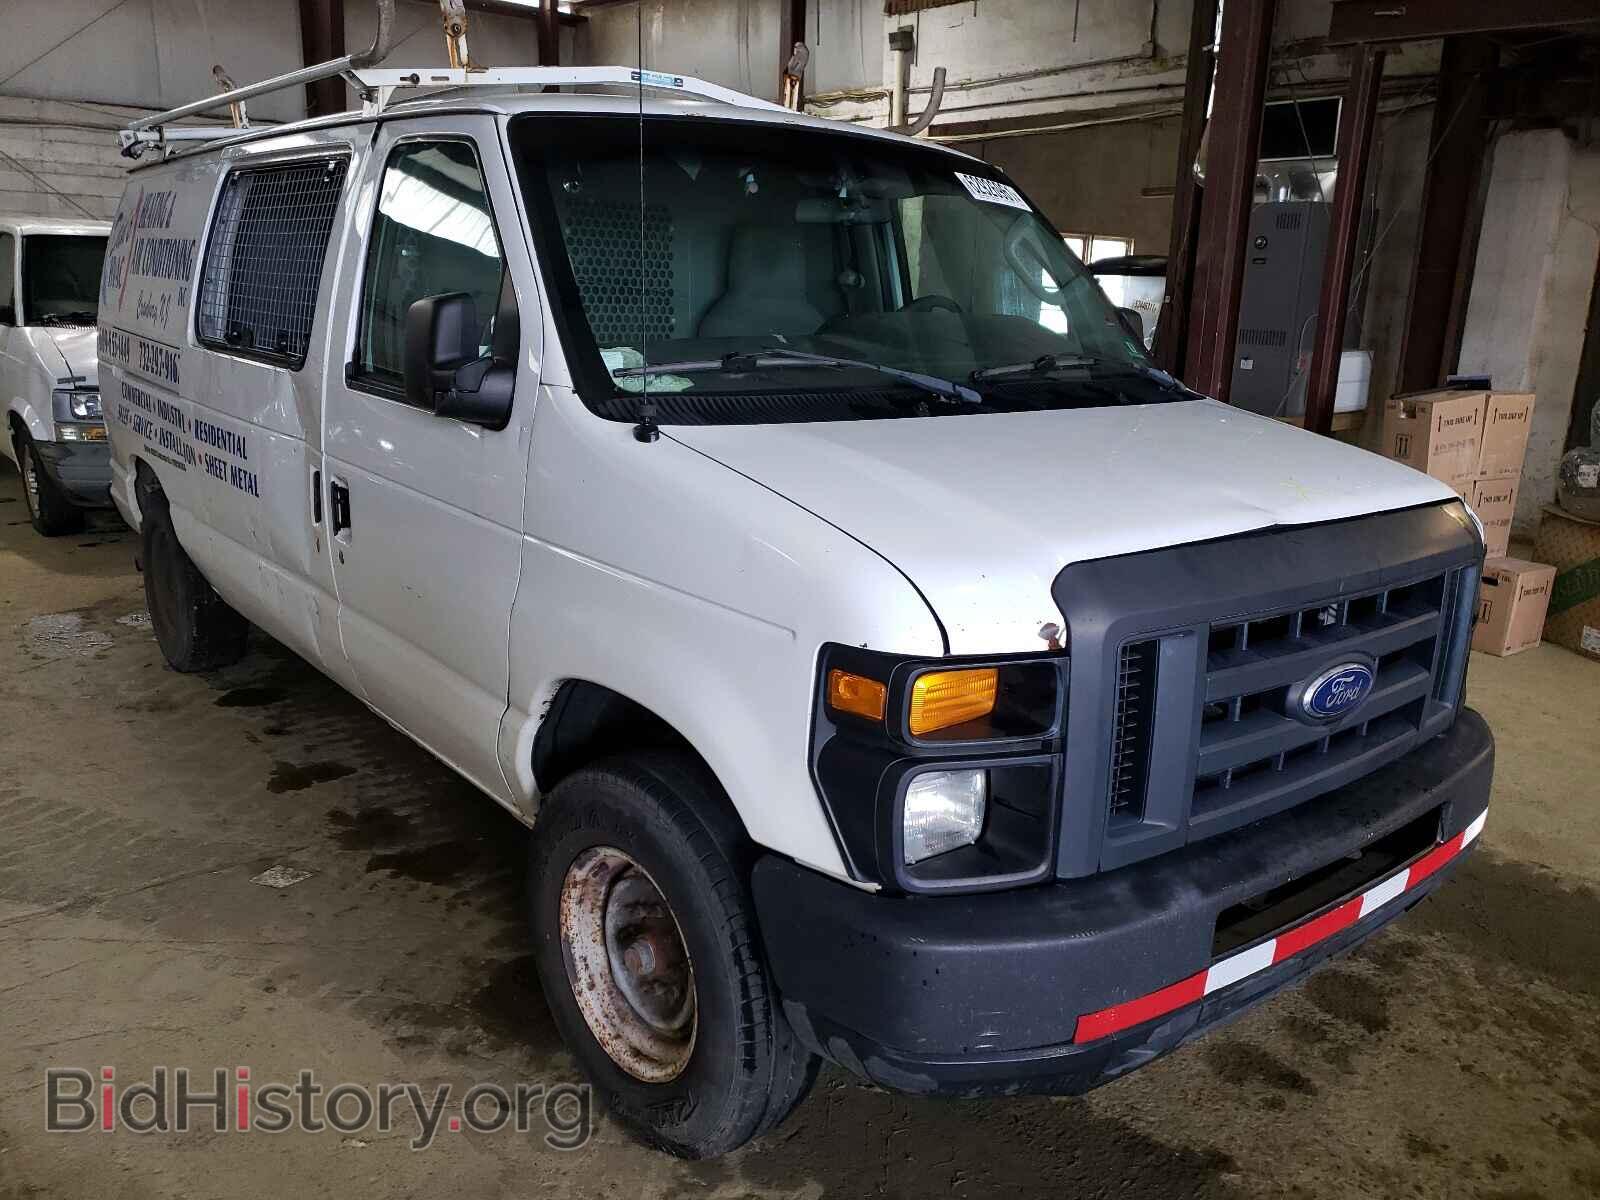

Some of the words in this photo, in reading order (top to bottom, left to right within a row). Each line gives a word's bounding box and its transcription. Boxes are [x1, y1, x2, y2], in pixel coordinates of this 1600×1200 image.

[142, 238, 195, 282] CONDITIONING
[133, 414, 153, 440] SERVICE
[205, 453, 228, 482] SHEET
[231, 464, 260, 498] METAL
[194, 418, 248, 460] RESIDENTIAL
[1326, 675, 1363, 708] Ford
